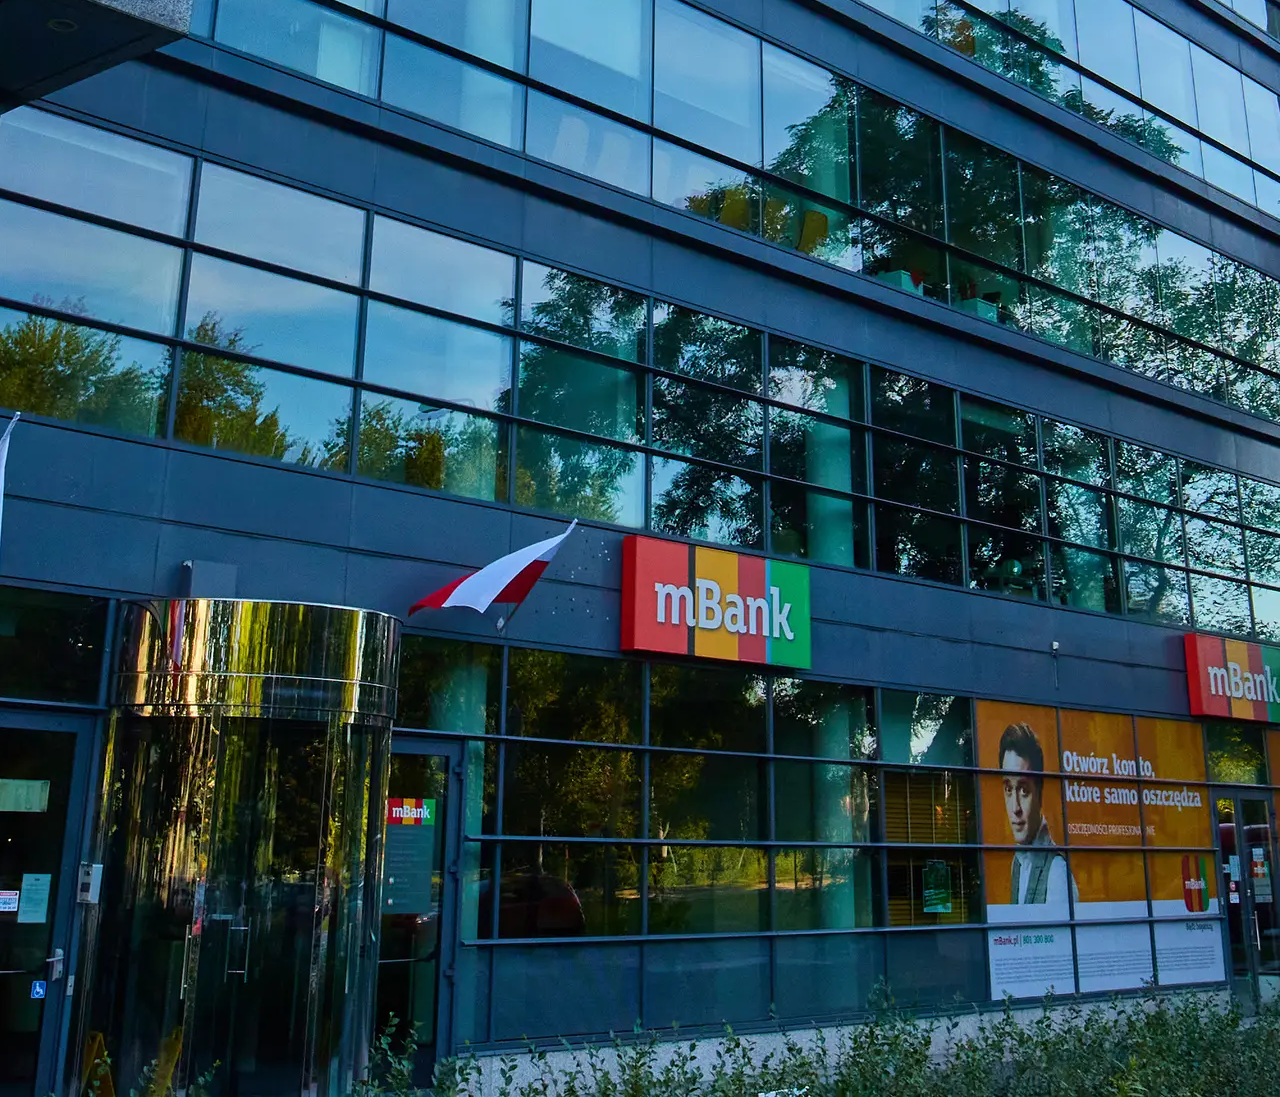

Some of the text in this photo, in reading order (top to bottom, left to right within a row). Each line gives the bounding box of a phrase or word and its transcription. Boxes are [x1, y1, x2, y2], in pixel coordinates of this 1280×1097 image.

[654, 578, 795, 641] mBank
[1207, 661, 1280, 704] mBank
[1062, 750, 1109, 775] Otwórz
[1064, 780, 1202, 812] które samo oszczędza
[392, 805, 431, 818] mBank
[1185, 877, 1206, 890] mBank
[993, 934, 1019, 947] mBank.pl
